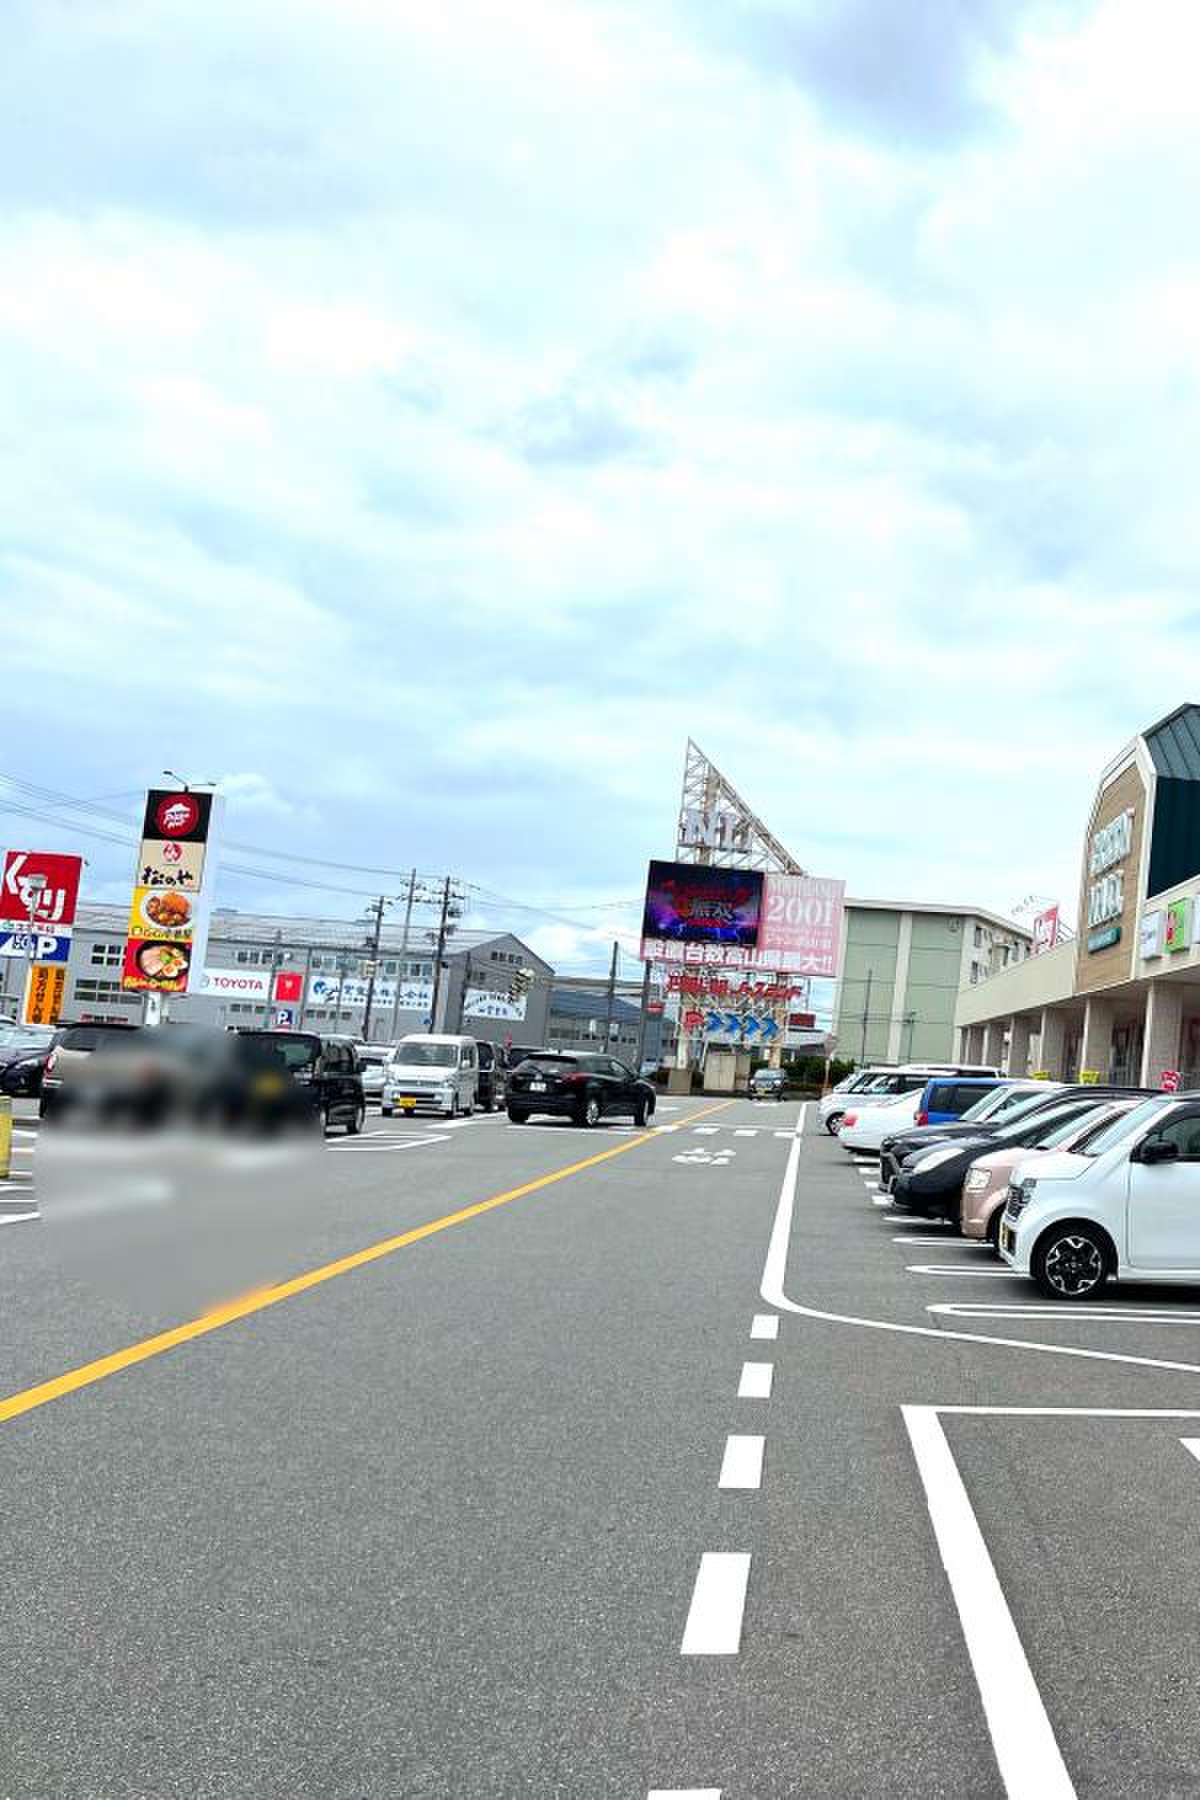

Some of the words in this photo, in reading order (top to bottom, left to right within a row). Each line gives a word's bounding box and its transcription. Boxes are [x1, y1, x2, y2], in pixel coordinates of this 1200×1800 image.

[5, 854, 66, 921] くすり
[768, 894, 833, 928] 2001
[36, 936, 58, 961] P
[214, 976, 264, 990] TOYOTA
